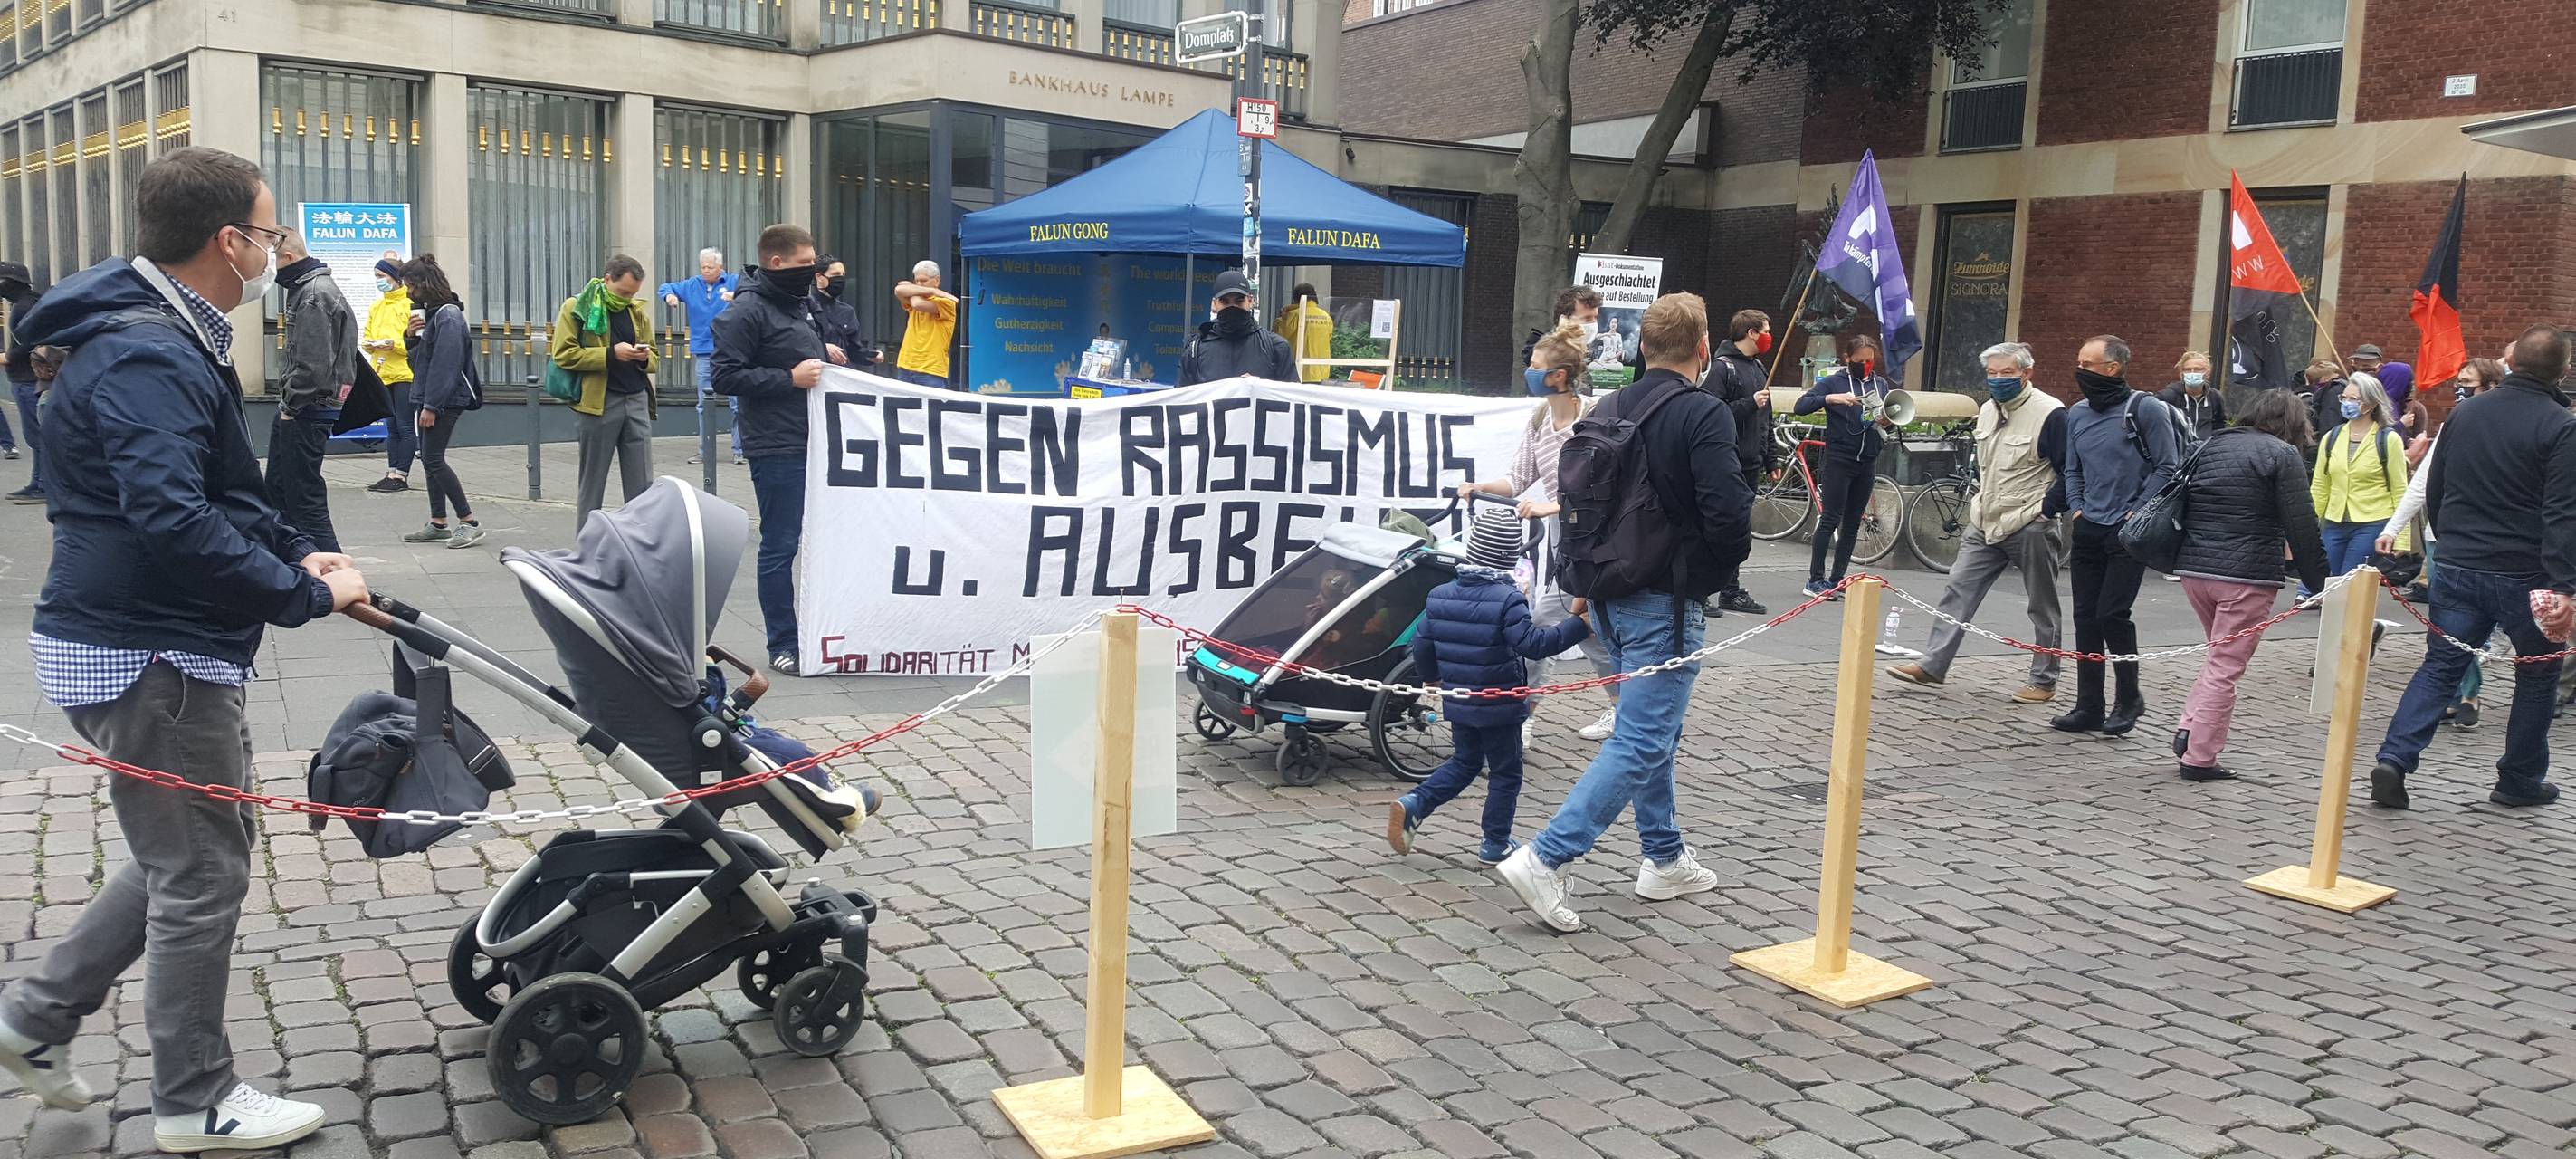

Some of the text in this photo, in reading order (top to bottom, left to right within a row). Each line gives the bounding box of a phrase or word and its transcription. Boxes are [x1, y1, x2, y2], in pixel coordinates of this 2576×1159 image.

[1008, 71, 1174, 107] BANKHAUS LAMPE
[1247, 103, 1267, 112] H150
[311, 211, 398, 225] 法輪大法
[312, 228, 398, 239] FALUN DAFA
[1030, 223, 1109, 242] FALUN GONG
[1287, 228, 1381, 249] FALUN DAFA
[978, 256, 1082, 275] Die Welt braucht
[1130, 265, 1151, 280] The
[1154, 267, 1187, 282] world
[1583, 271, 1656, 289] Ausgeschlachtet
[1605, 291, 1617, 302] auf
[1618, 291, 1654, 305] Bestellung
[1951, 283, 2008, 297] SIGNORA
[991, 292, 1067, 309] Wahrhaftigkeit
[994, 318, 1064, 332] Gutherzigkeit
[1004, 340, 1054, 353] Nachsicht
[825, 391, 1475, 498] GEGEN RASSISMUS
